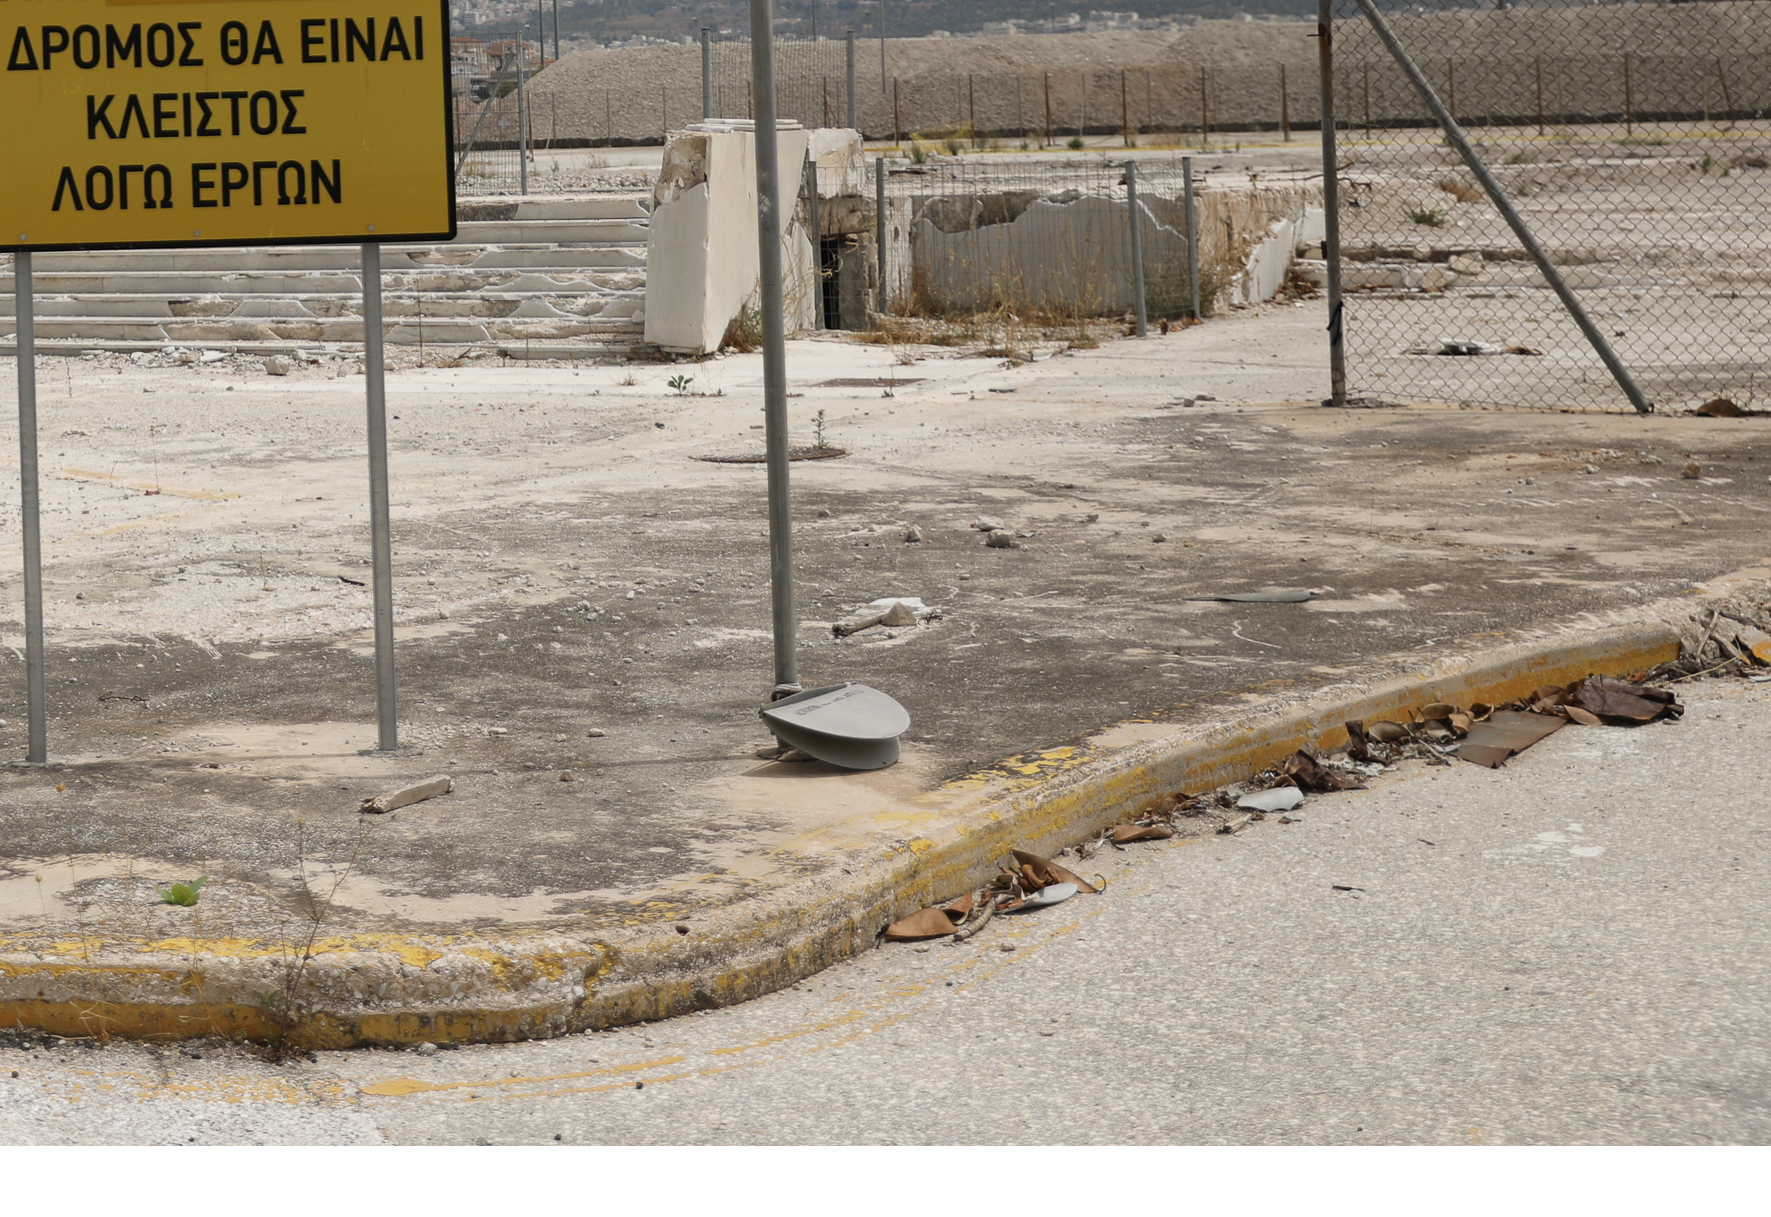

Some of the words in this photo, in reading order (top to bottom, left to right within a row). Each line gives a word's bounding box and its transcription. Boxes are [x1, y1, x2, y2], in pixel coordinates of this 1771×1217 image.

[6, 21, 204, 72] ΔΡΟΜΟΣ
[220, 19, 284, 66] ΘΑ
[300, 15, 424, 64] ΕΙΝΑΙ
[86, 89, 307, 140] ΚΛΕΙΣΤΟΣ
[51, 163, 174, 212] ΛΟΓΩ
[191, 158, 342, 208] ΕΡΓΩΝ
